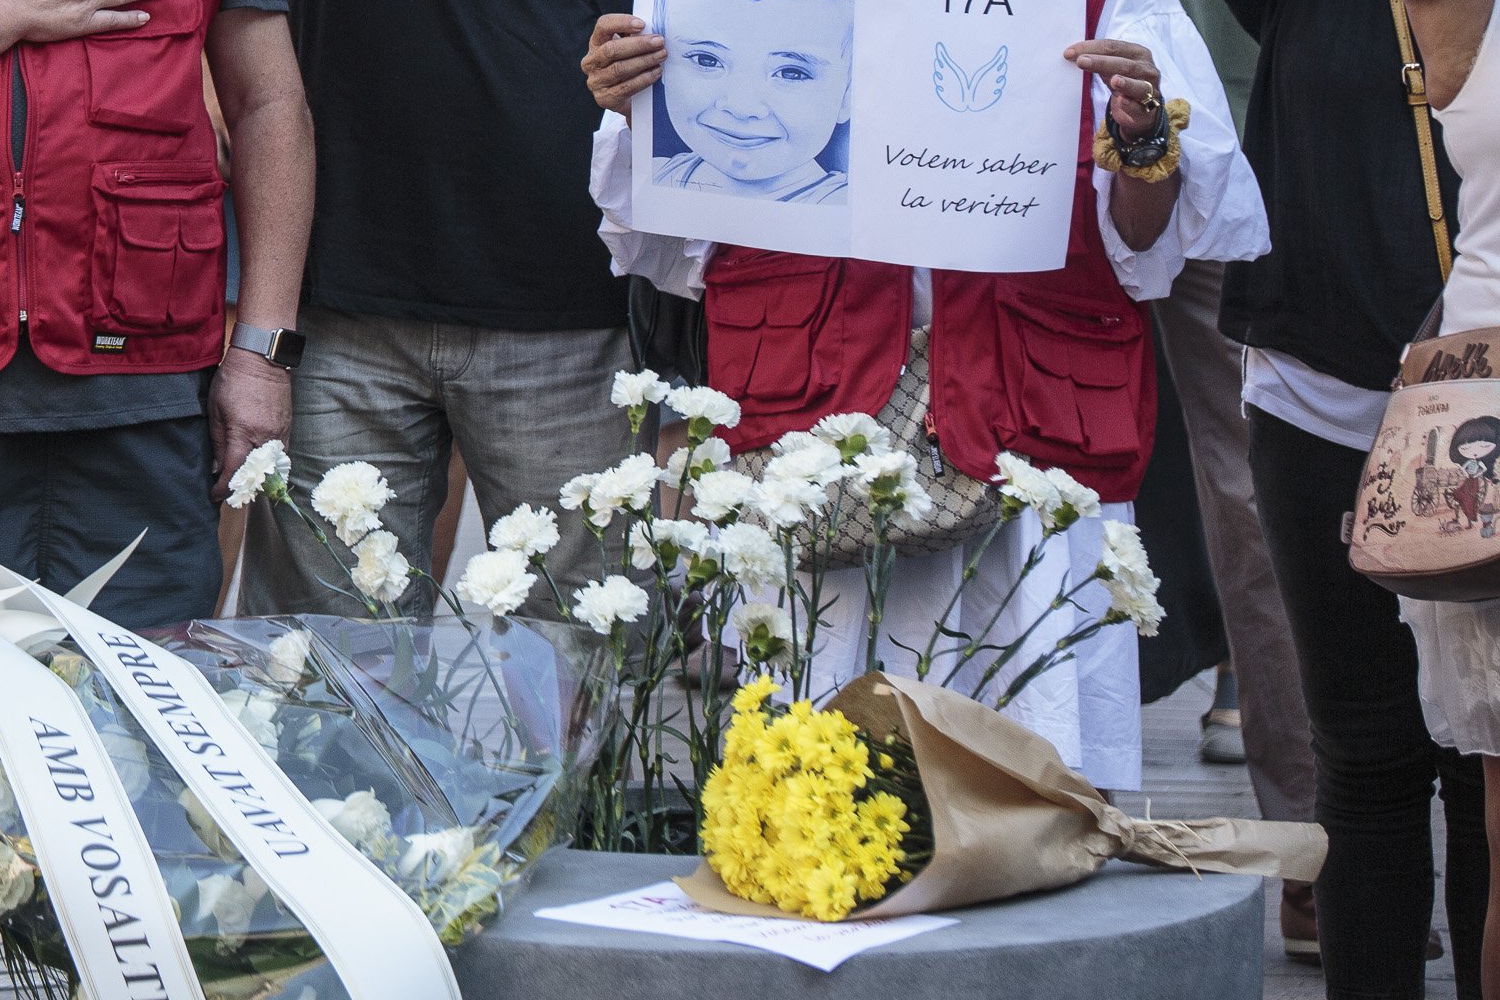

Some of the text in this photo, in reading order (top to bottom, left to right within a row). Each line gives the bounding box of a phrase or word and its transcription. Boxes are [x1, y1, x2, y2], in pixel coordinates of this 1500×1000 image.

[886, 145, 1058, 176] Volem saber
[901, 188, 1040, 218] la veritat
[97, 631, 226, 757] SEMPRE
[28, 715, 95, 803] AMB
